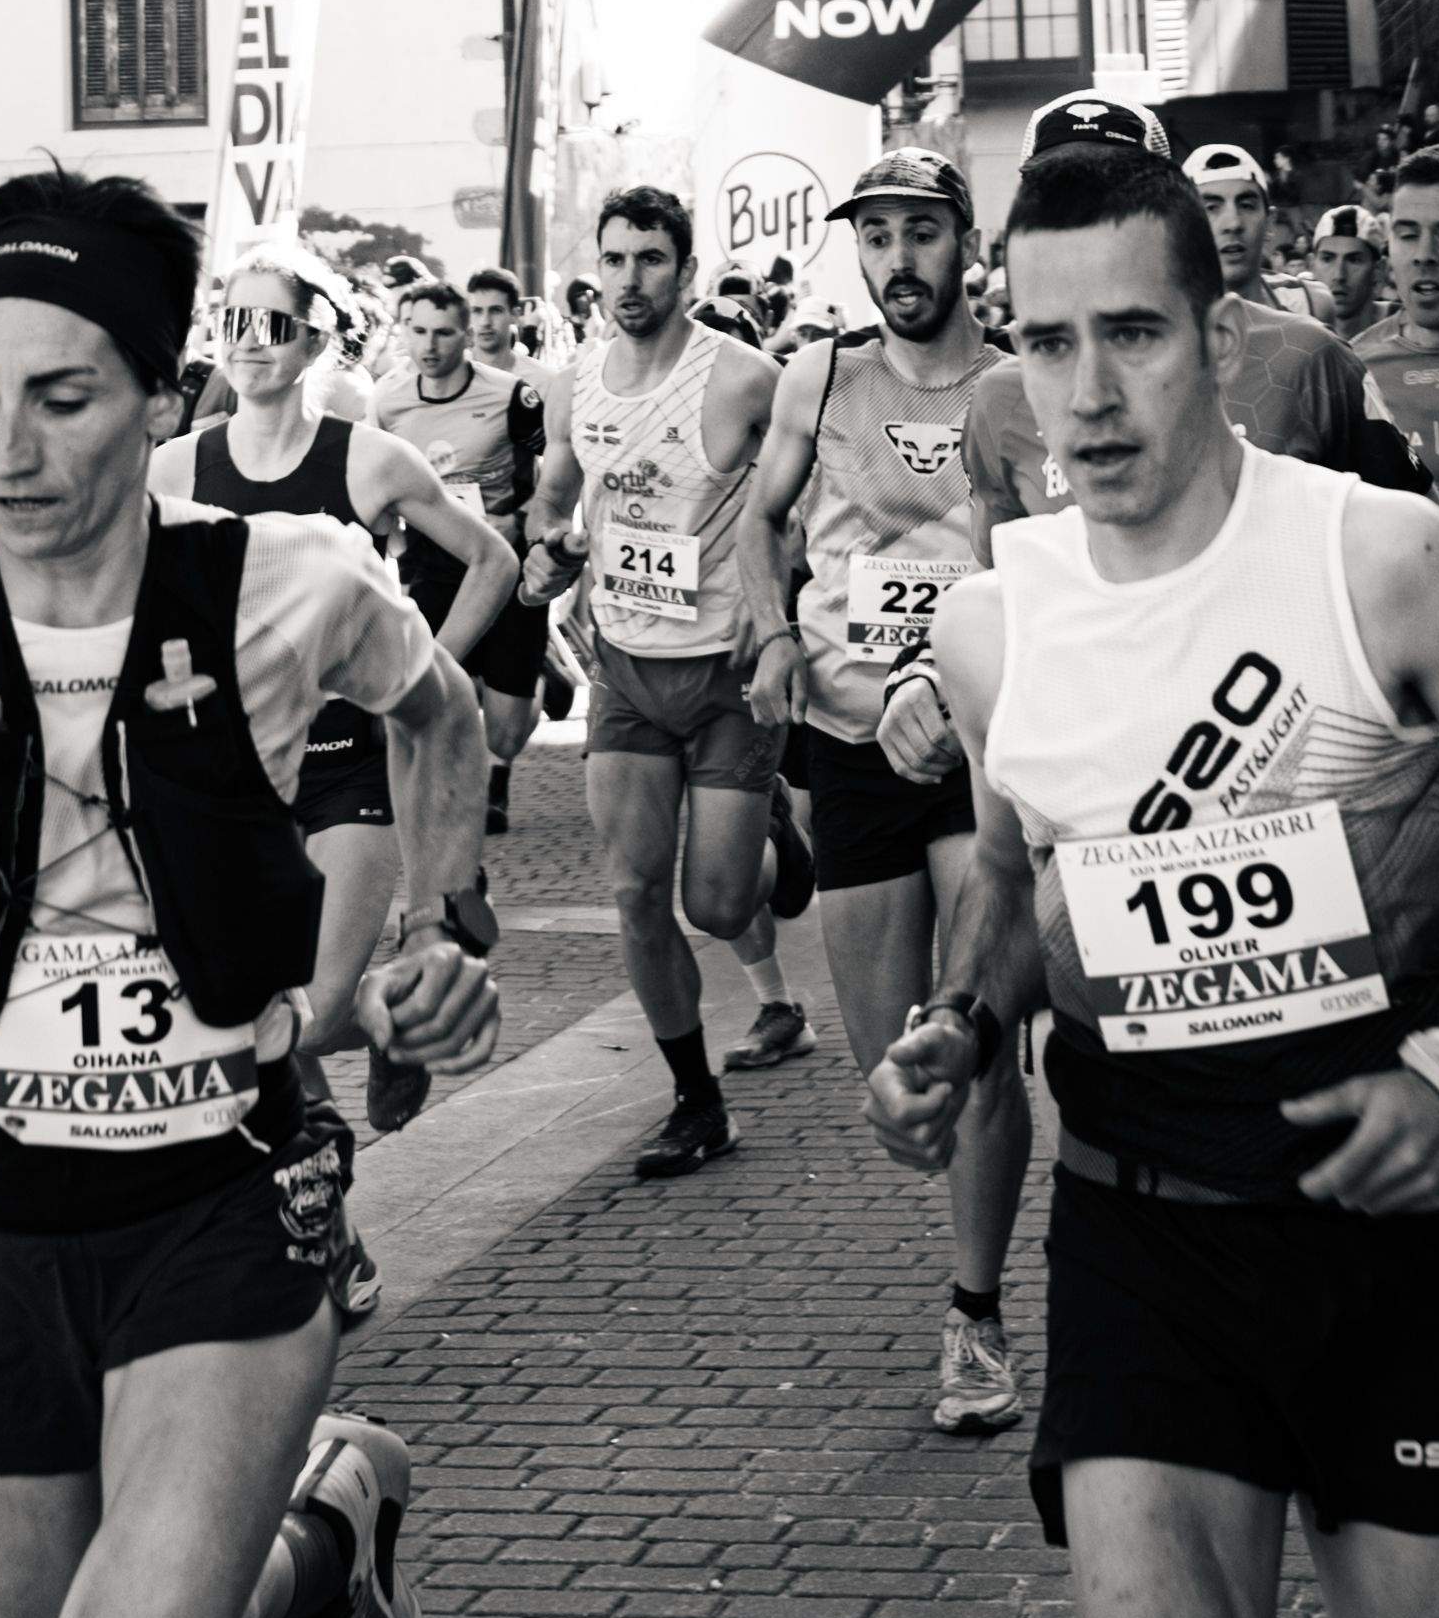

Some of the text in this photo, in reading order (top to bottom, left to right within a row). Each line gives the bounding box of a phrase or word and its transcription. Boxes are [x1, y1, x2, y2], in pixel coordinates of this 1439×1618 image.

[620, 544, 676, 578] 214
[612, 578, 687, 605] ZEGAMA
[880, 580, 955, 615] 22
[29, 676, 121, 695] SALOMO
[303, 737, 354, 753] OMON
[1217, 682, 1309, 817] FAST&LIGHT
[1080, 811, 1318, 867] ZEGAMA-AIZKORRI
[1125, 862, 1295, 946] 199
[1179, 938, 1260, 964] OLIVER
[1118, 945, 1350, 1014] ZEGAMA
[62, 979, 174, 1048] 13
[1187, 1009, 1284, 1036] SALOMON
[73, 1049, 163, 1070] OIHANA
[5, 1057, 235, 1113] ZEGAMA
[69, 1120, 168, 1140] SALOMON
